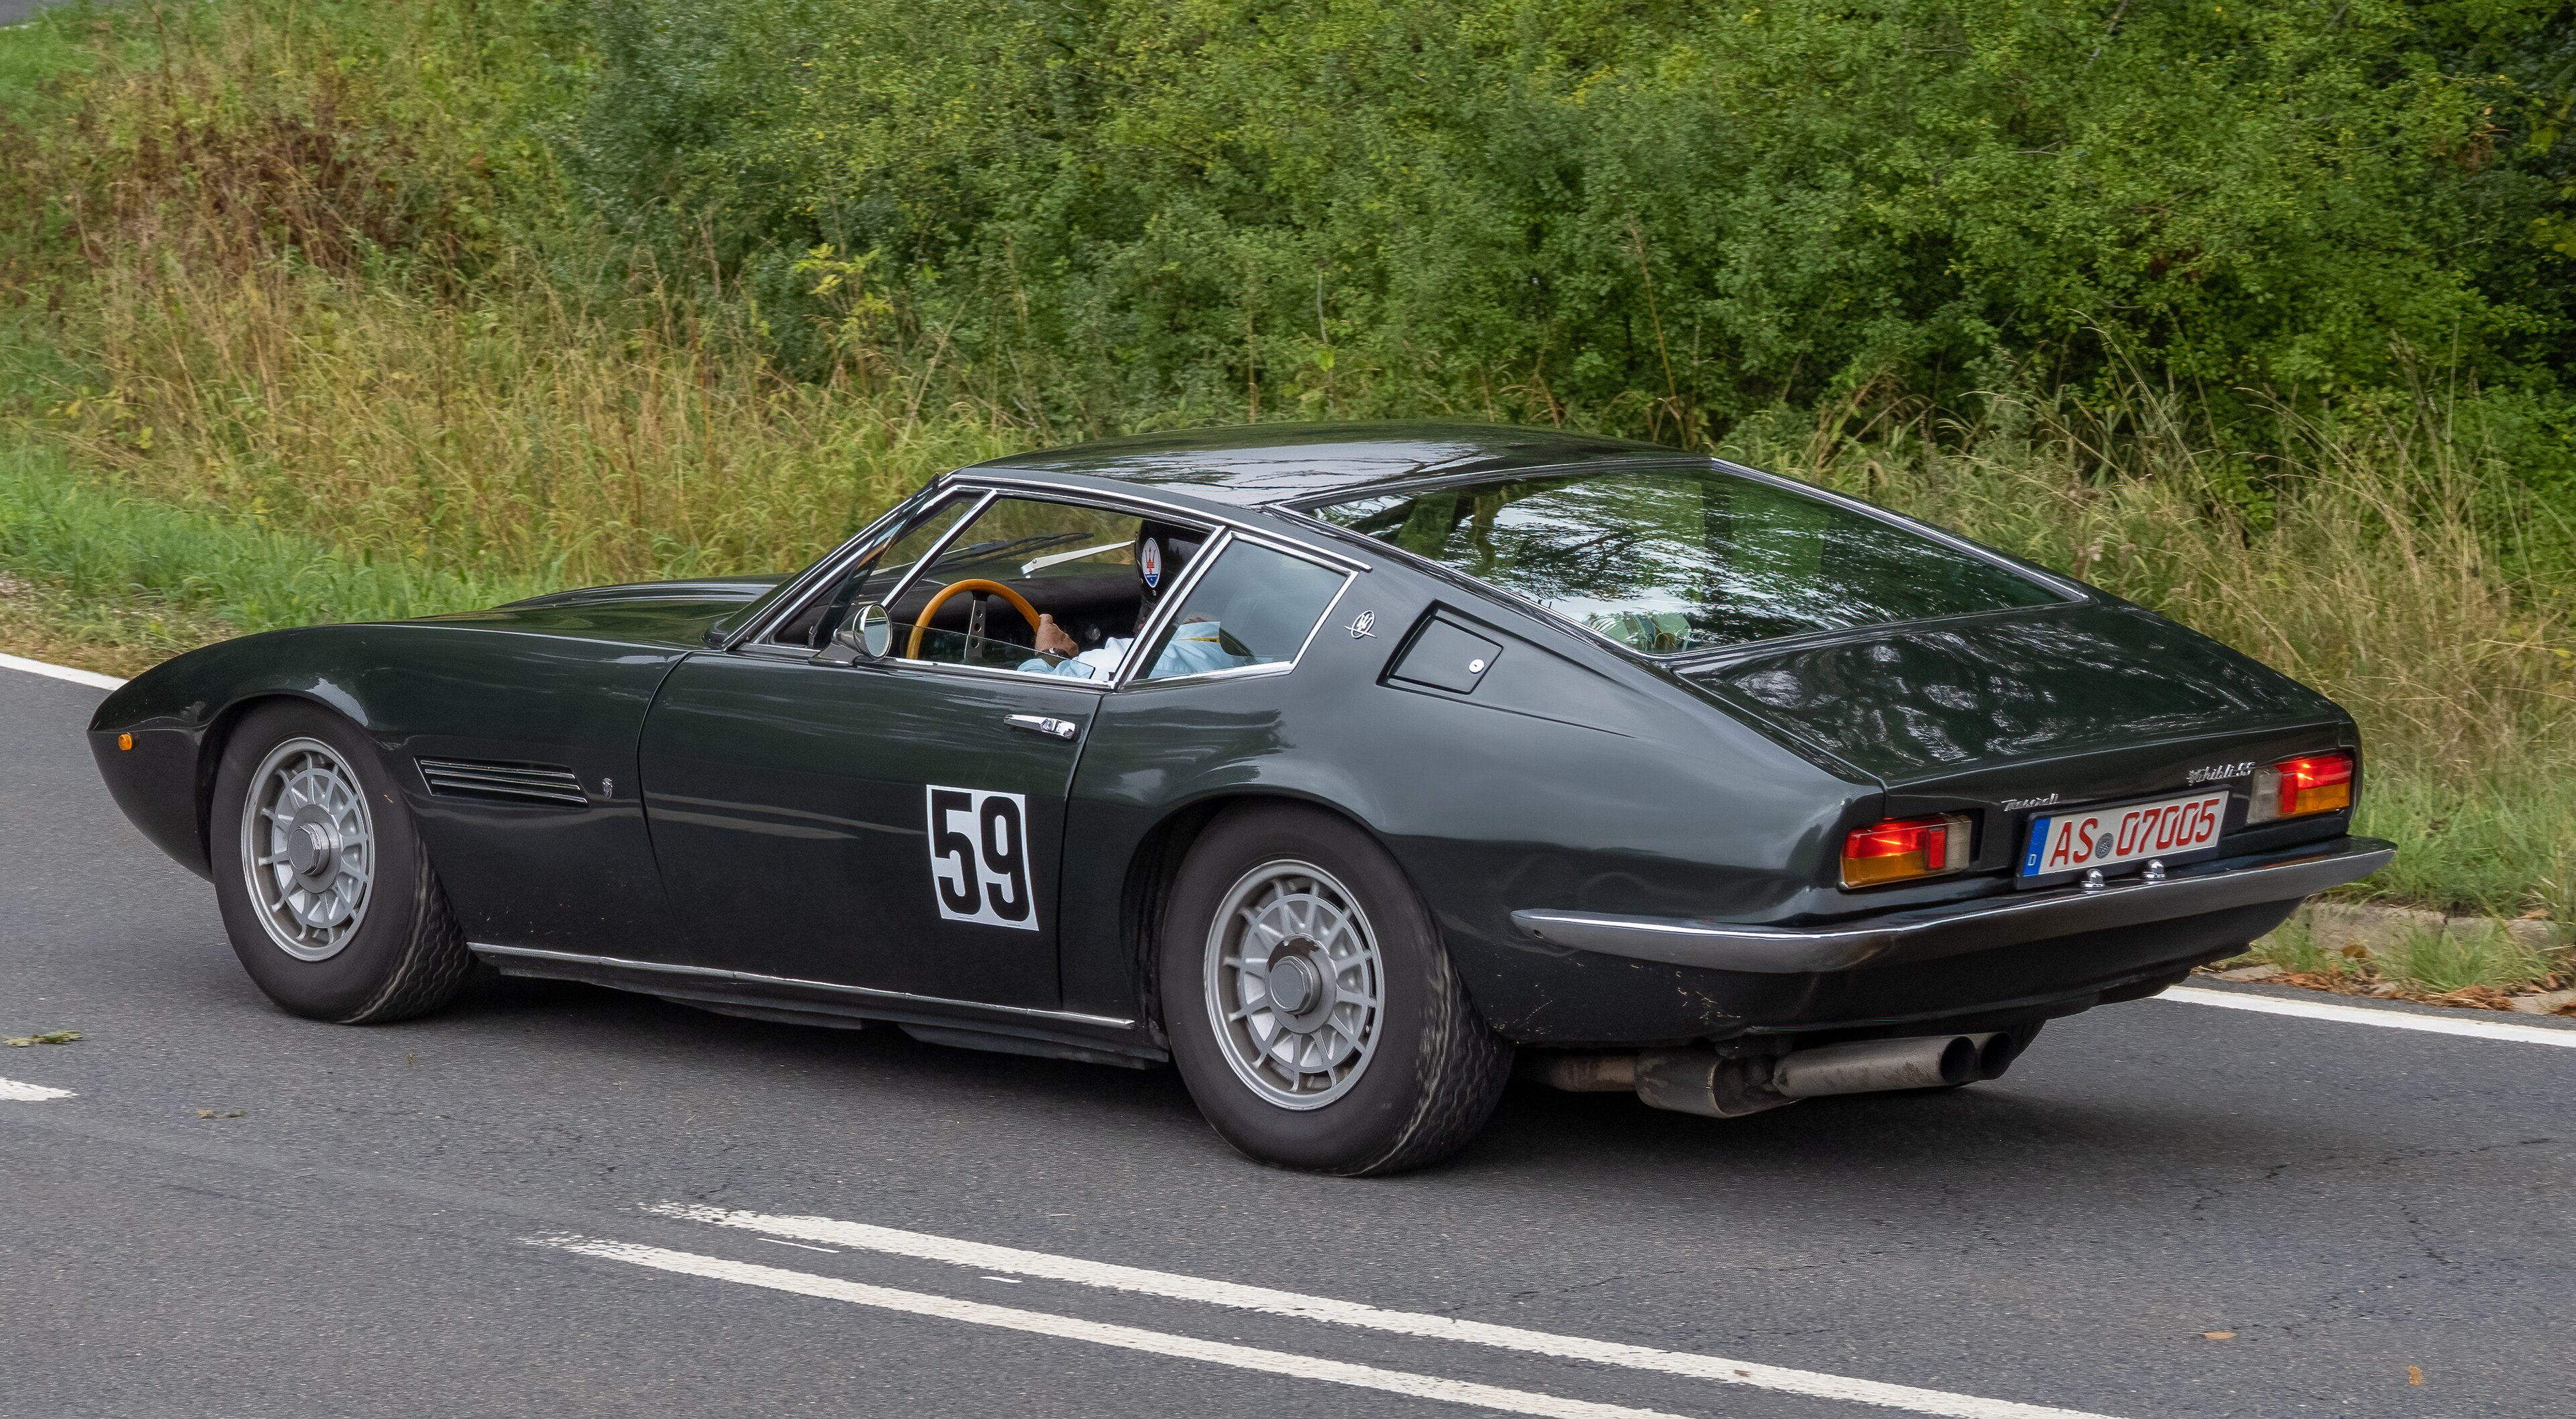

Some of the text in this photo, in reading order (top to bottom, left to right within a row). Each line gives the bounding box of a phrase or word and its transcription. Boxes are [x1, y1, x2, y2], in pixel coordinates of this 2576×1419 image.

[931, 788, 1031, 923] 59
[2027, 853, 2037, 866] D
[2049, 798, 2220, 867] AS 07005
